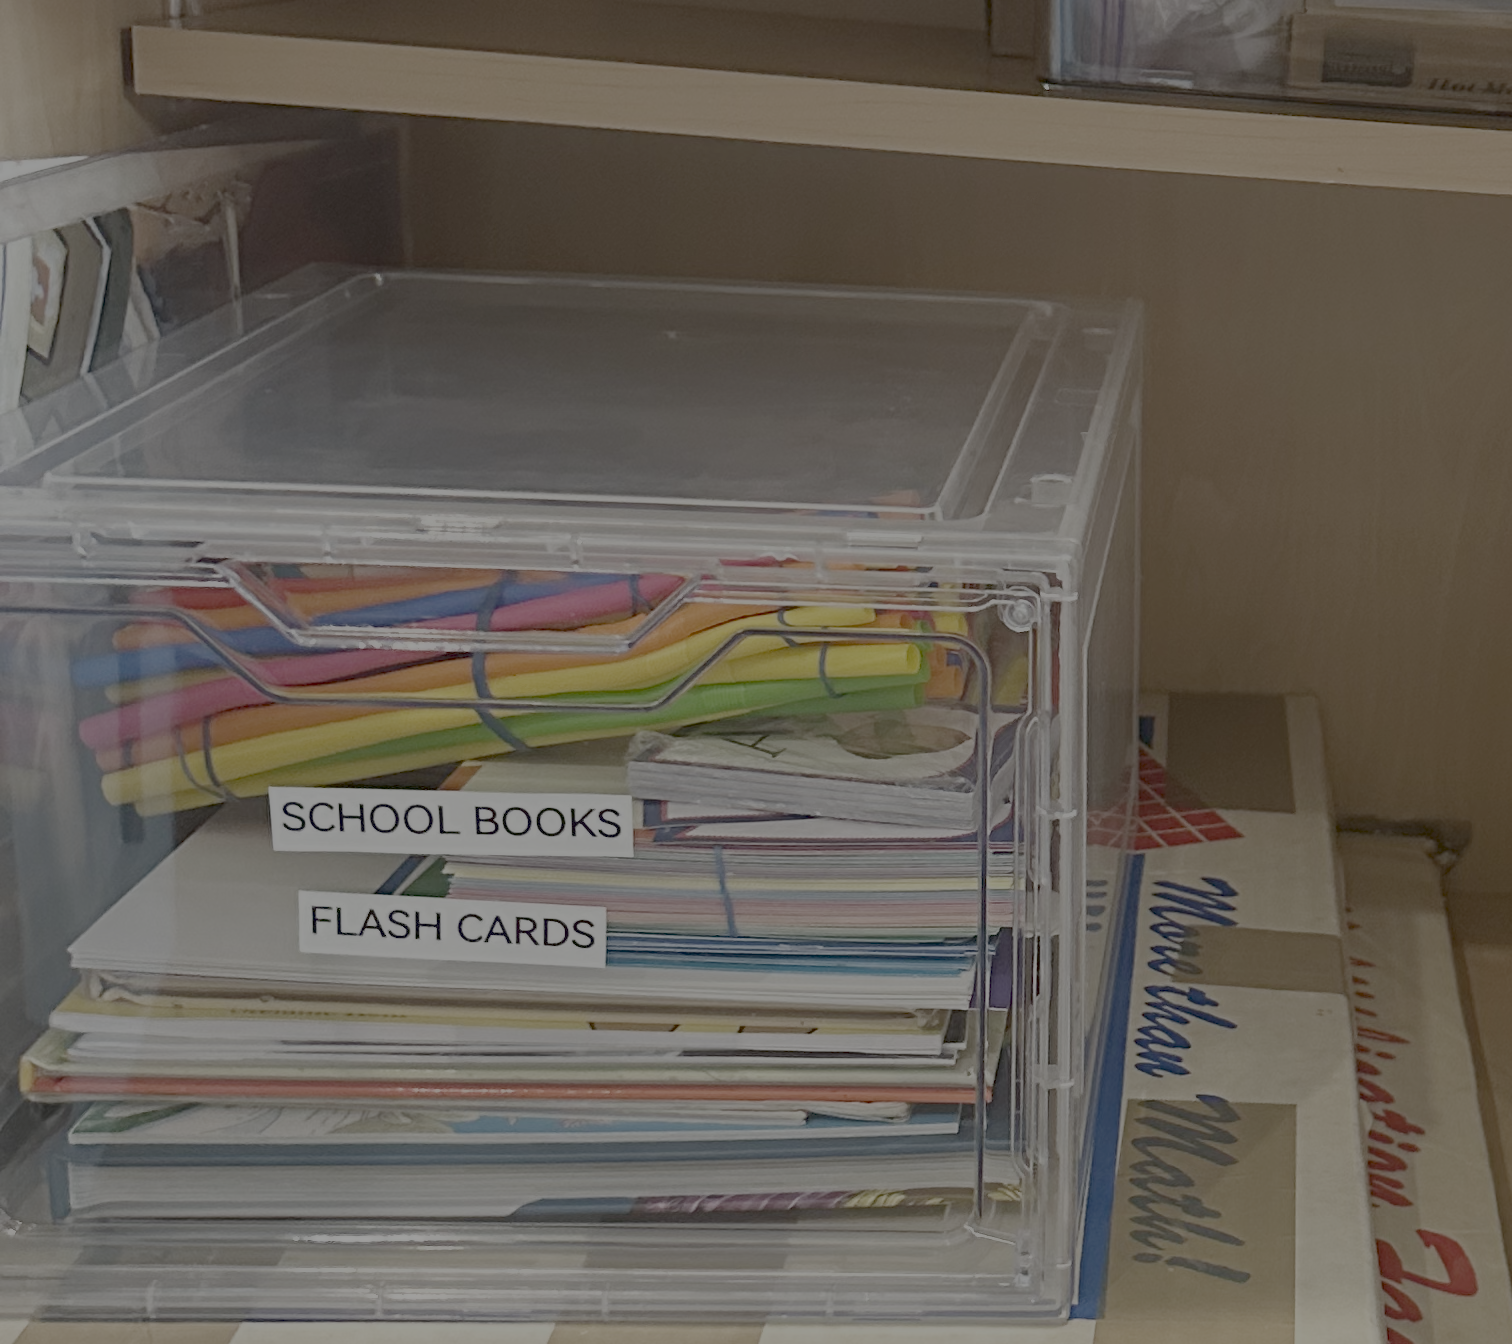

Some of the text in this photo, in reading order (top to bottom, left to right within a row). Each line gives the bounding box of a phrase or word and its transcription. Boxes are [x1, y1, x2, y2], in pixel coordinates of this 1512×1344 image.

[282, 801, 622, 838] SCHOOL BOOKS
[311, 905, 596, 949] FLASH CARDS
[1128, 876, 1251, 1284] More than Math!
